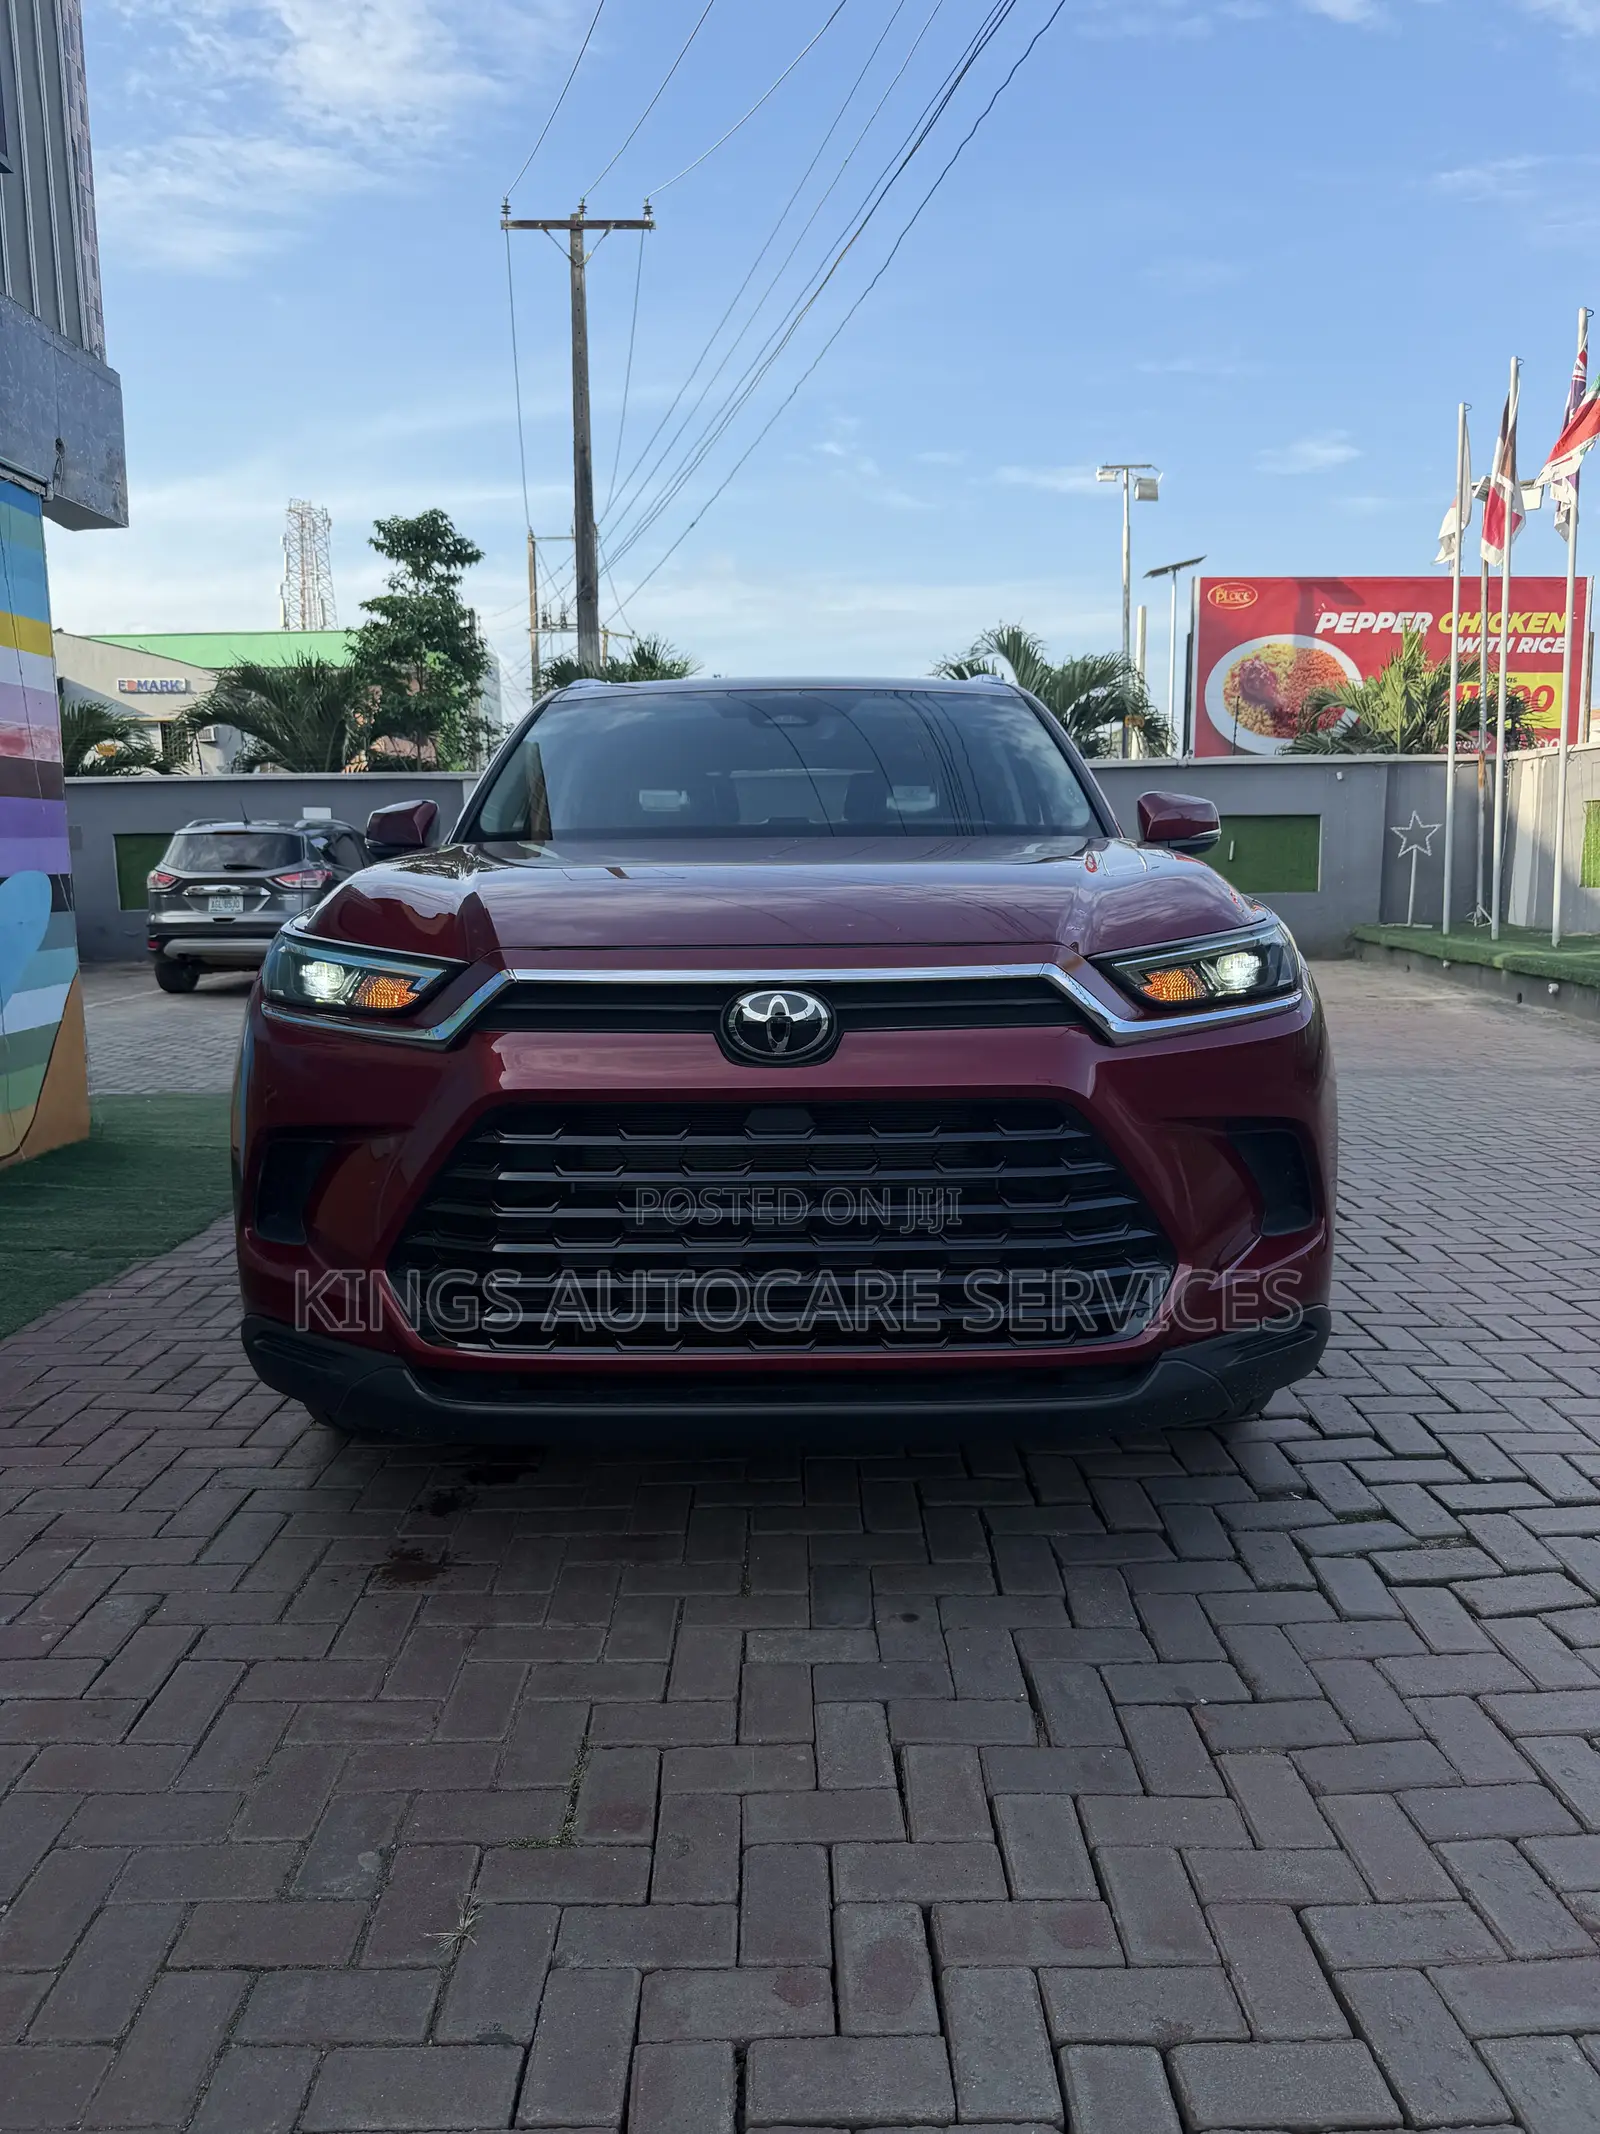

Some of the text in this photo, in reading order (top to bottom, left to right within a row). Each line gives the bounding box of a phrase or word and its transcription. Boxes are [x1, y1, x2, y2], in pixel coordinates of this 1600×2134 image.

[1314, 611, 1434, 636] PEPPER
[1457, 636, 1566, 654] WTH RICE
[118, 680, 180, 692] EDMARK
